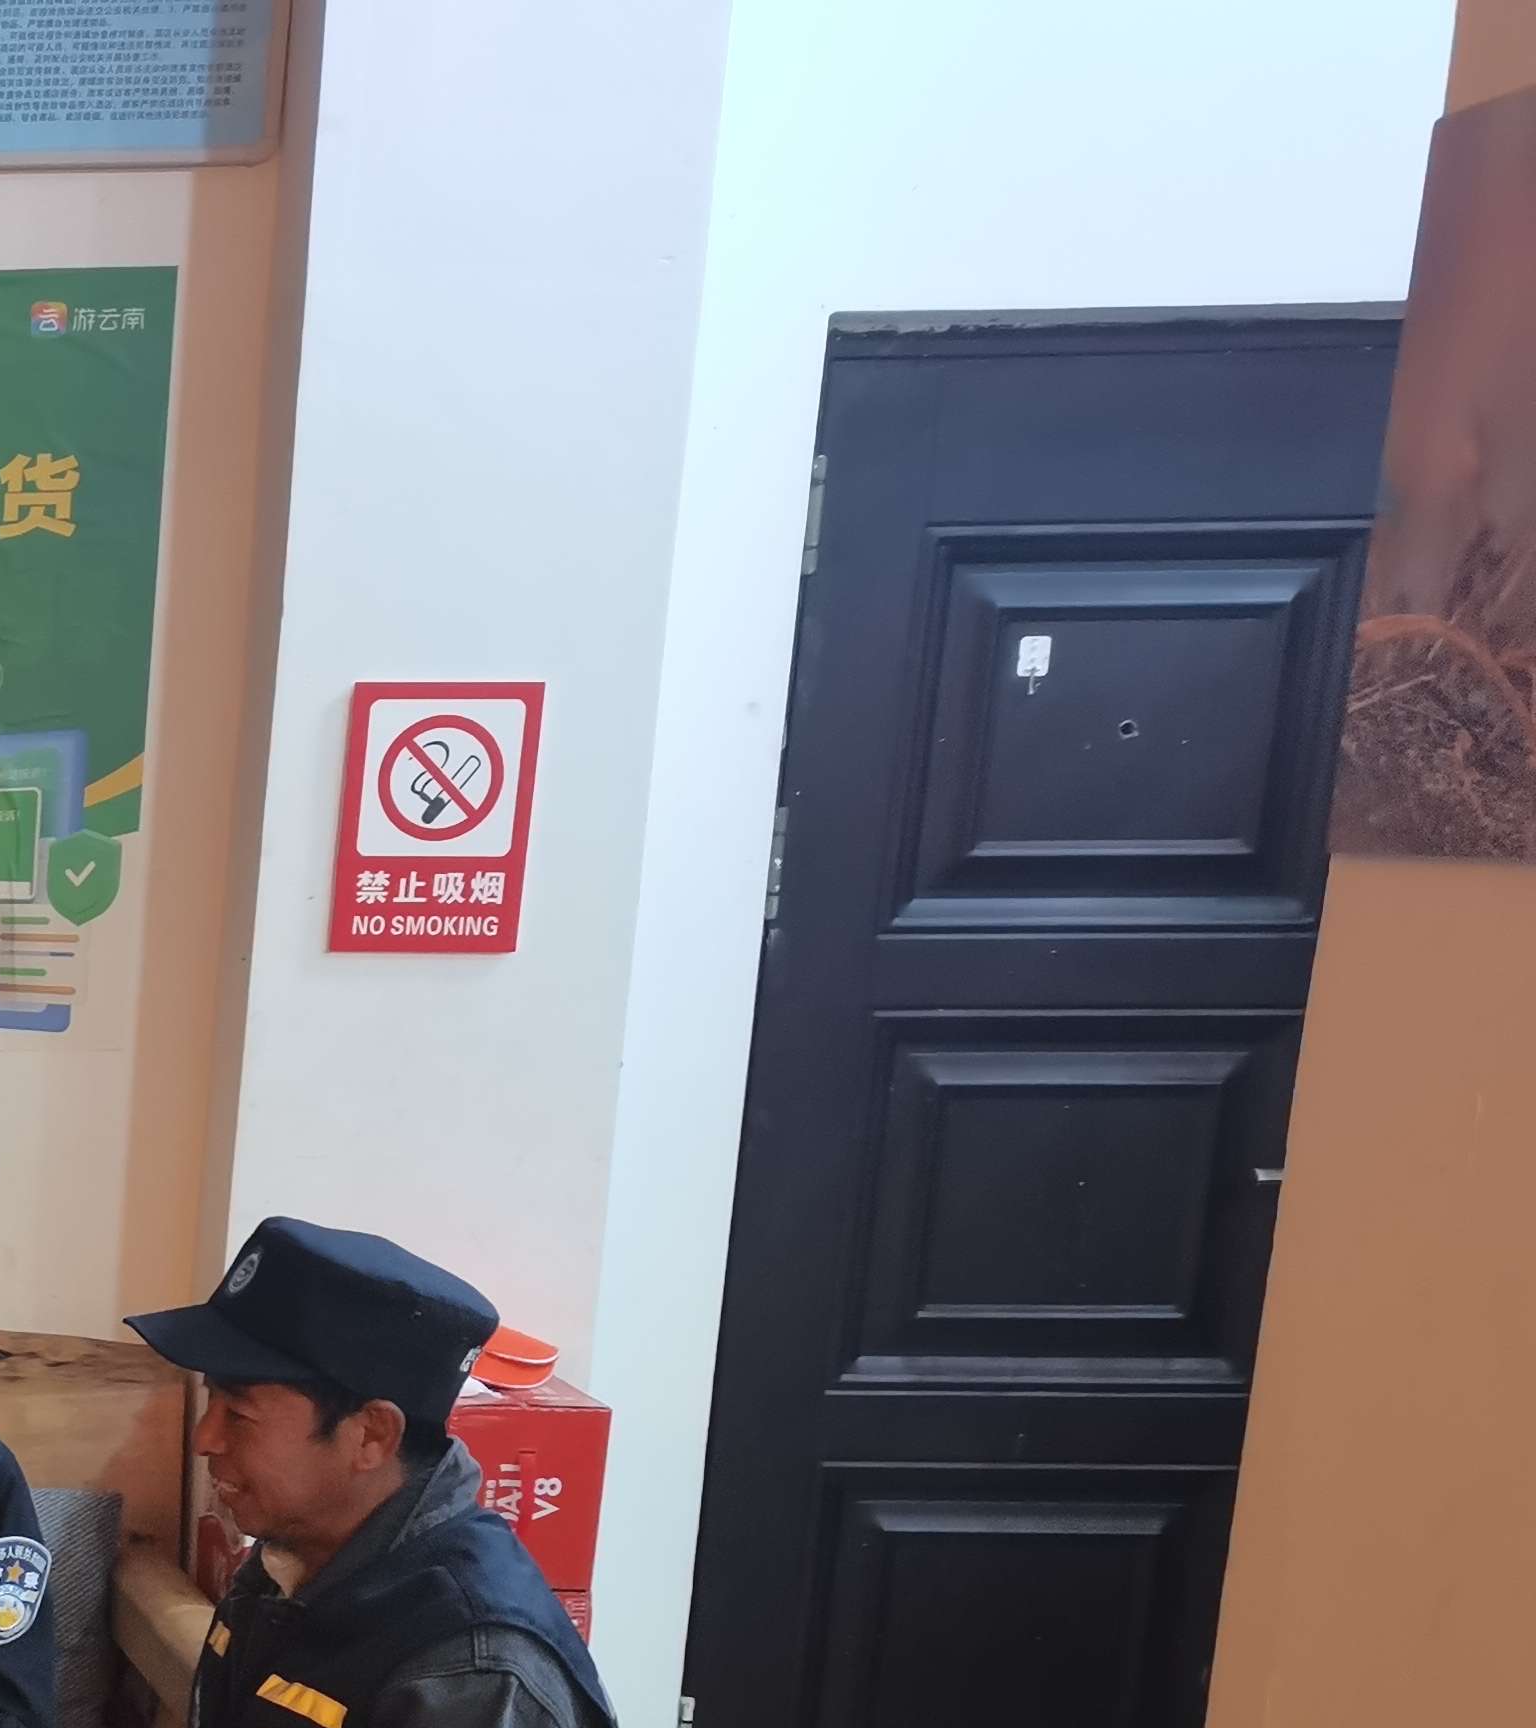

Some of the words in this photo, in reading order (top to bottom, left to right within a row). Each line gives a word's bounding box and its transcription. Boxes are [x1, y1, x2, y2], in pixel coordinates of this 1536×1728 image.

[72, 306, 146, 333] 游云南
[355, 870, 506, 905] 禁止吸烟
[352, 915, 385, 935] NO
[390, 915, 499, 937] SMOKING
[531, 1477, 562, 1521] V8
